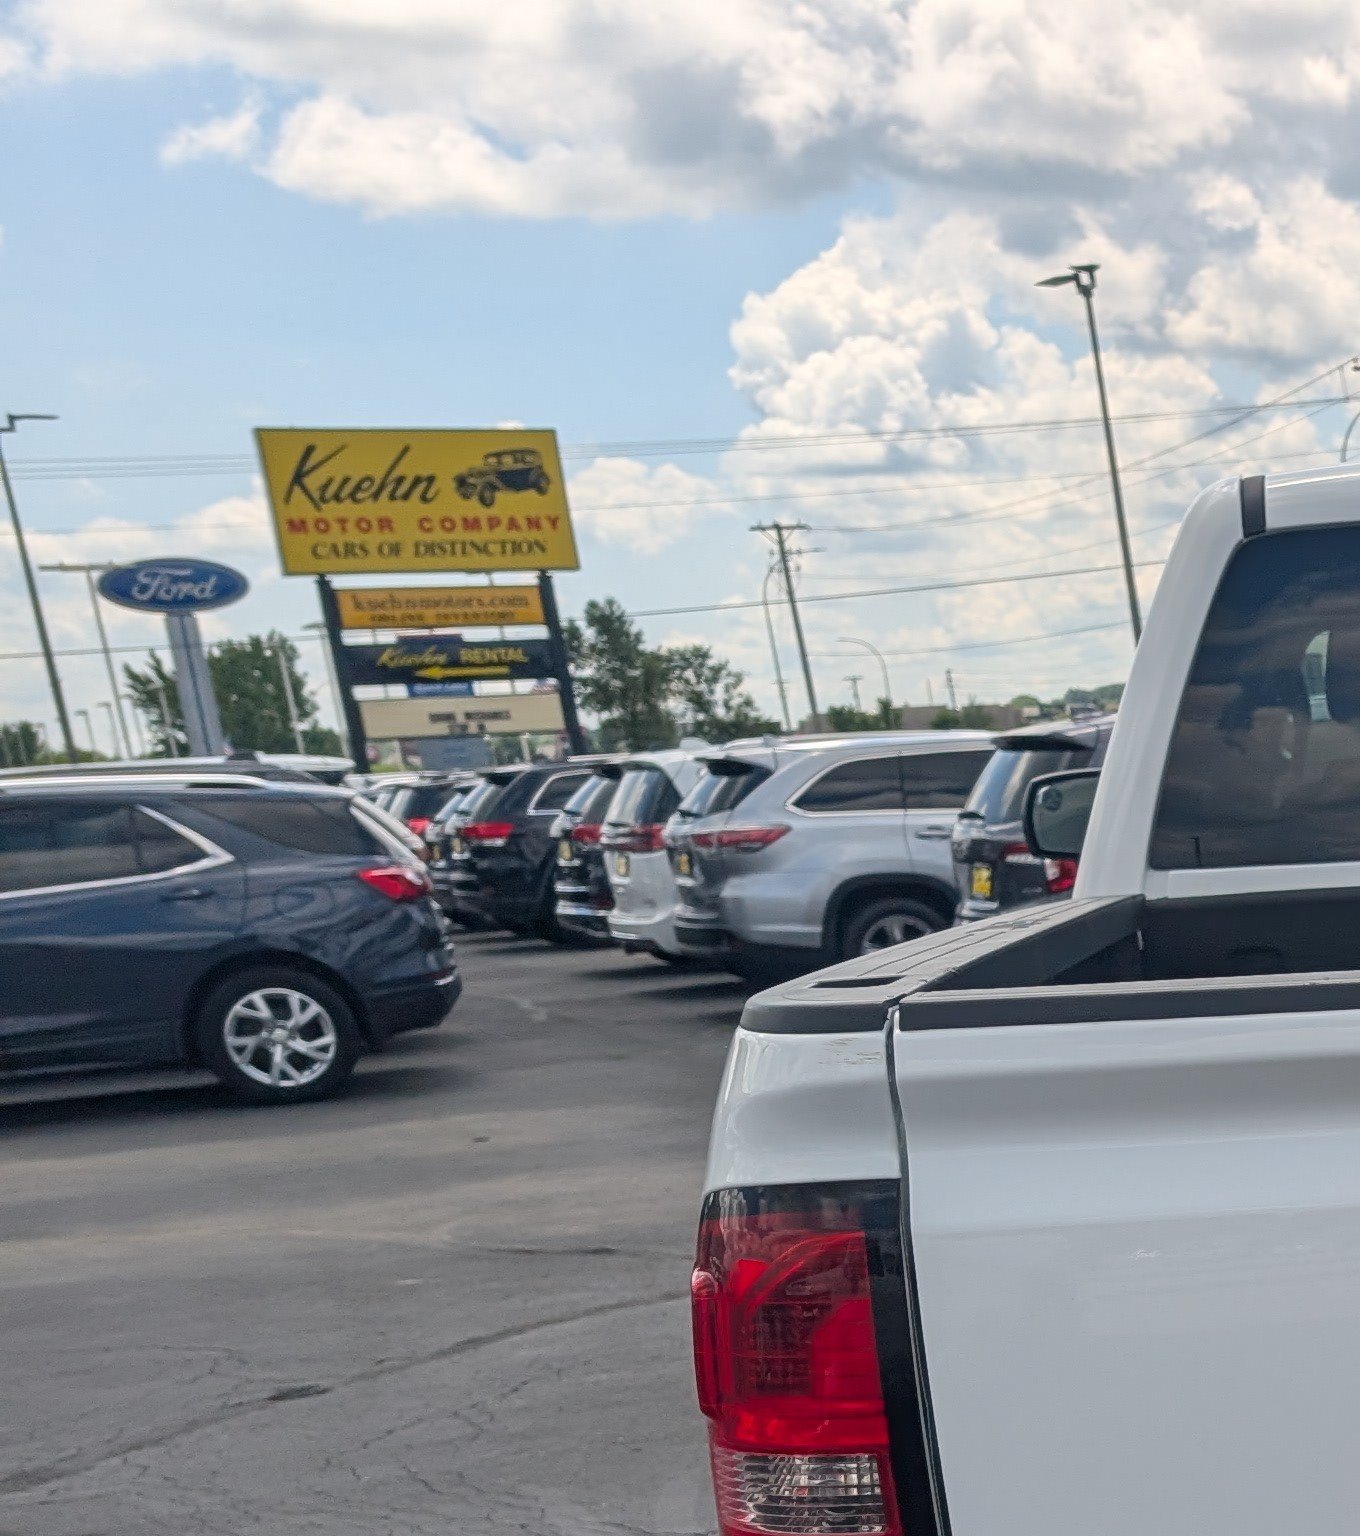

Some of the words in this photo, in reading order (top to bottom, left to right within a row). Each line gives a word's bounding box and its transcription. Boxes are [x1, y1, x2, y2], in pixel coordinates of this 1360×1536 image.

[283, 443, 441, 512] Kuehn
[285, 517, 395, 534] MOTOR
[417, 515, 560, 533] COMPANY
[311, 540, 368, 560] CARS
[377, 539, 404, 559] OF
[413, 538, 548, 558] DISTINCTION
[132, 566, 217, 601] Ford
[351, 592, 529, 611] kuehnmotors.com
[377, 645, 448, 669] Kuehn
[458, 646, 529, 664] RENTAL
